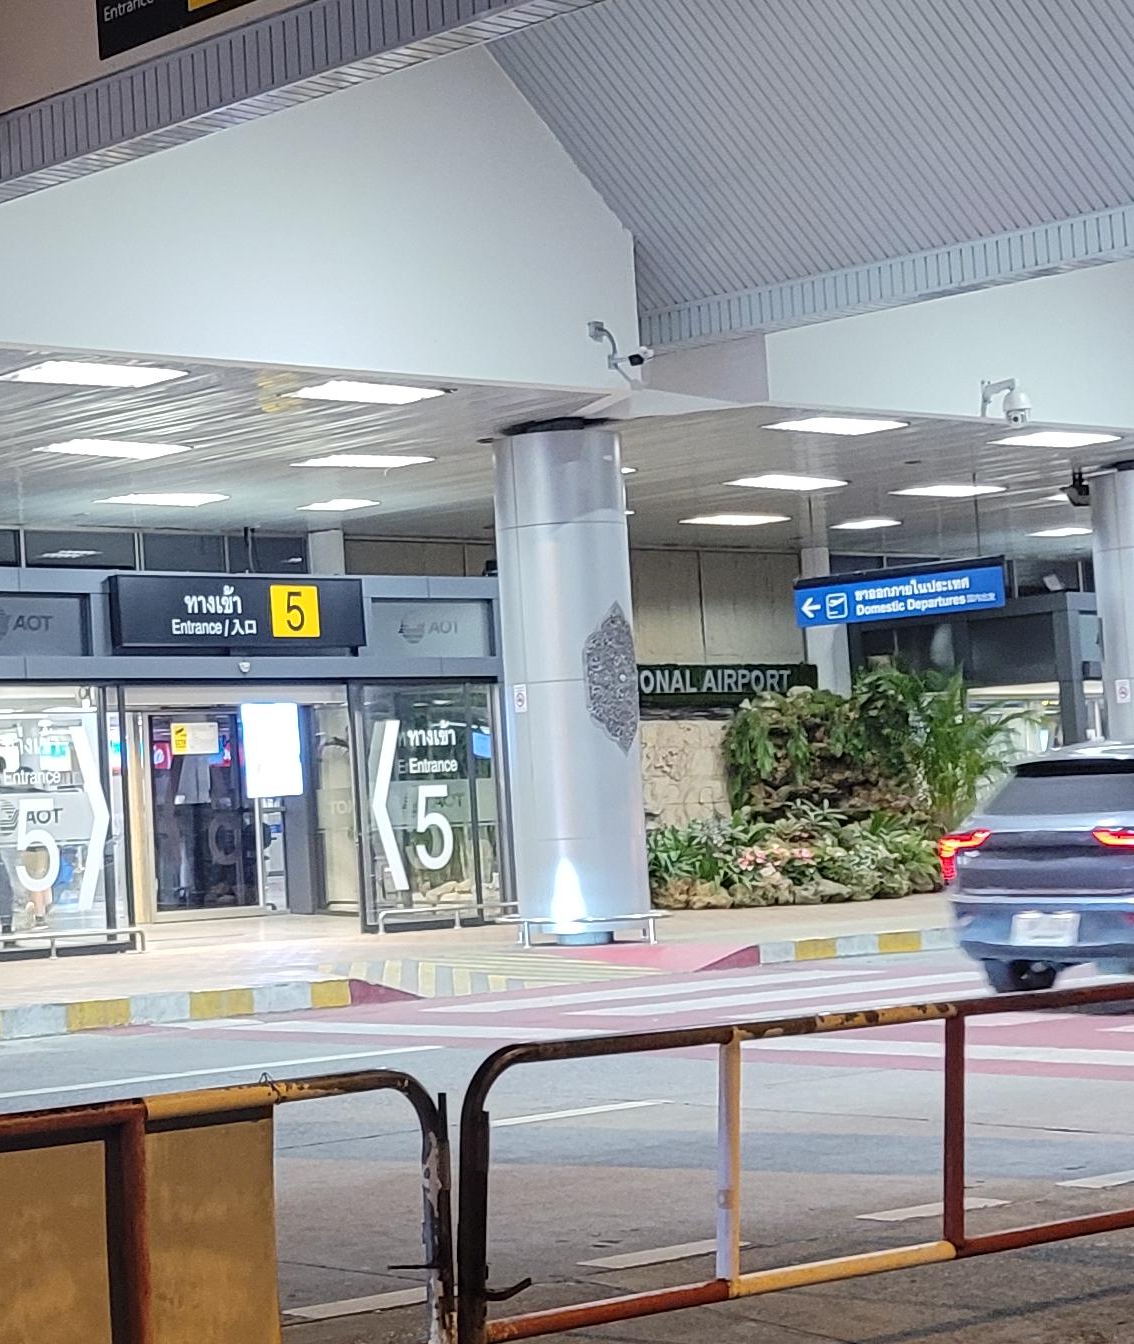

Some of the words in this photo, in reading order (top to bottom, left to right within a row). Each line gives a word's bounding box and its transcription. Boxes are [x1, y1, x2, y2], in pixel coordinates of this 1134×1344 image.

[183, 584, 243, 615] ทางเข้า
[856, 599, 905, 616] Domestic
[907, 594, 966, 614] Departures
[286, 591, 305, 632] 5
[12, 615, 54, 632] AOT
[171, 618, 223, 635] Entrance
[701, 669, 792, 694] AIRPORT
[407, 719, 457, 747] ทางเข้า
[409, 757, 458, 774] Entrance
[3, 769, 61, 786] Entrance
[26, 807, 64, 824] AOT
[416, 784, 454, 870] 5
[16, 798, 61, 892] 5
